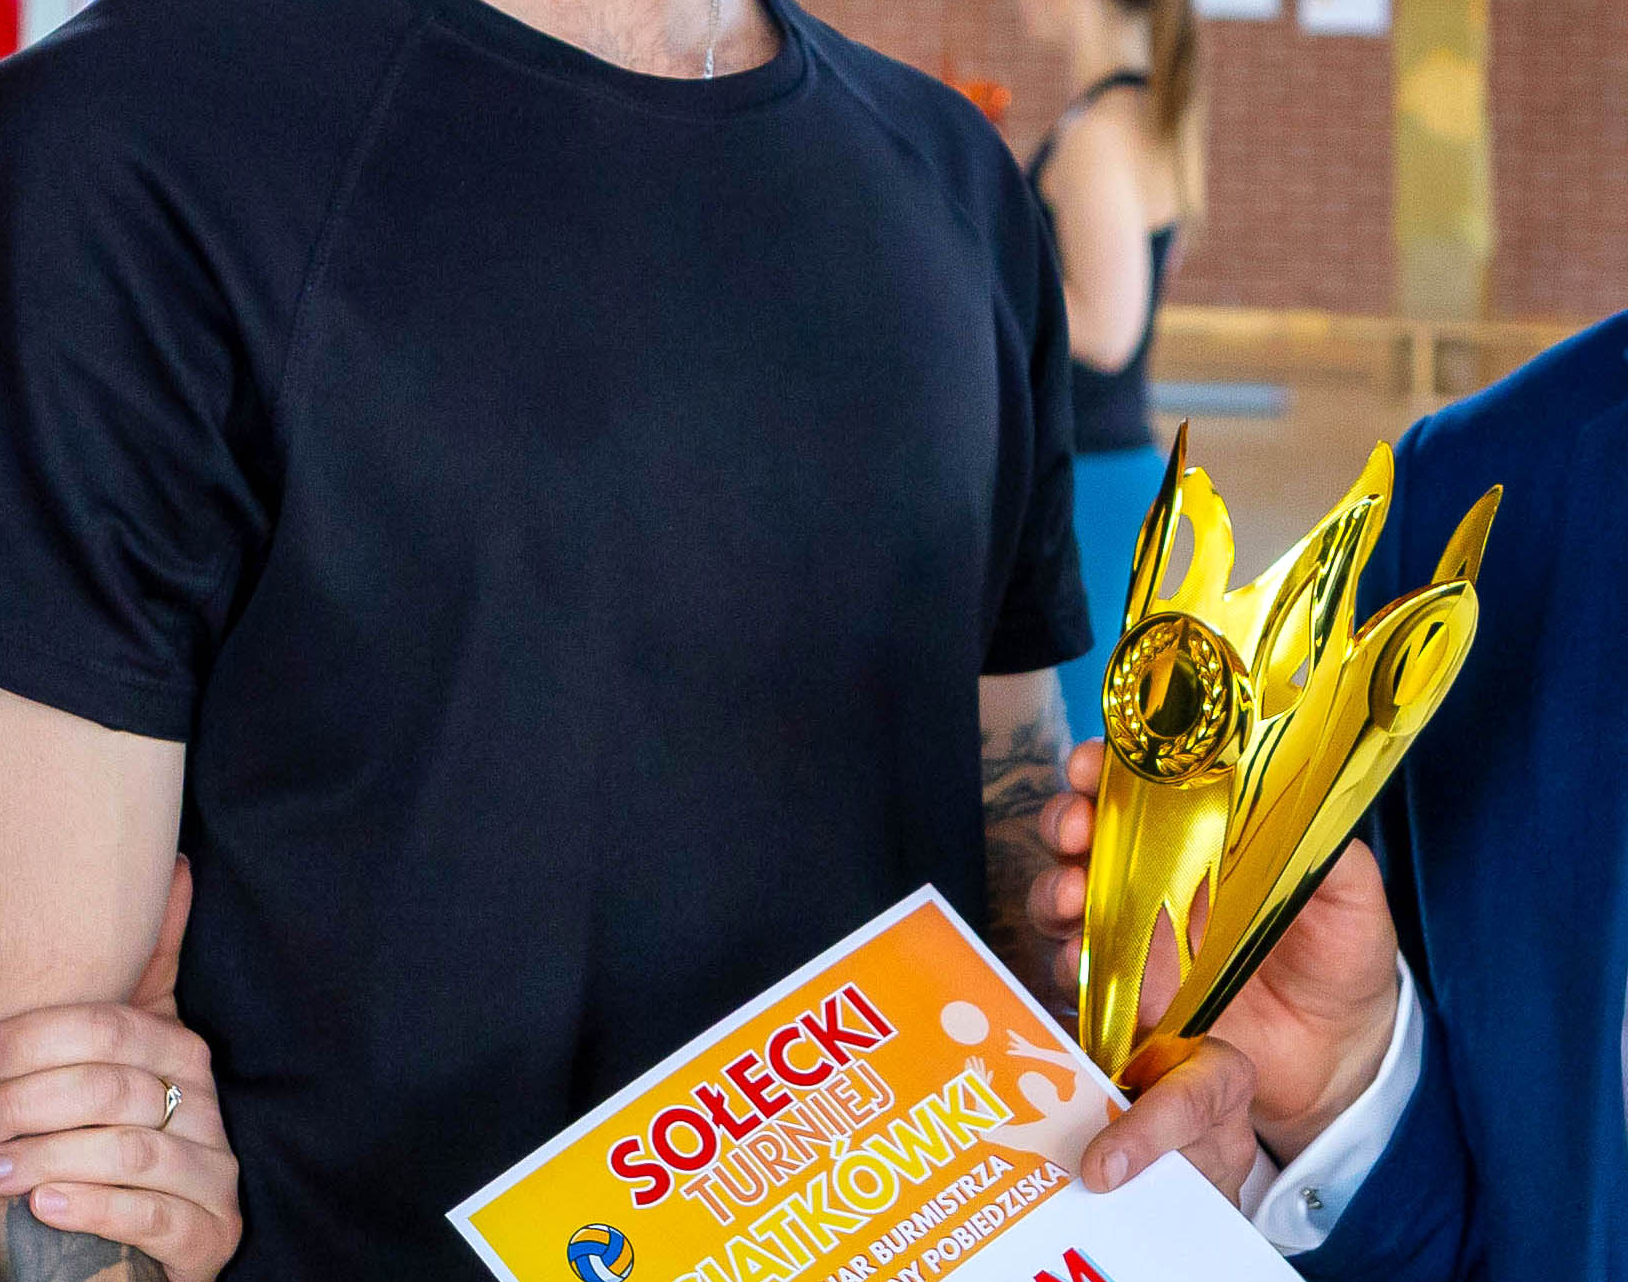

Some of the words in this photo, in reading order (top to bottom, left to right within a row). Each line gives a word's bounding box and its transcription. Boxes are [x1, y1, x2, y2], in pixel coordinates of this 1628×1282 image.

[607, 982, 899, 1209] SOŁECKI
[681, 1058, 895, 1226] TURNIEJ
[868, 1154, 1015, 1266] BURMISTRZA
[921, 1160, 1071, 1274] POBIEDZISKA
